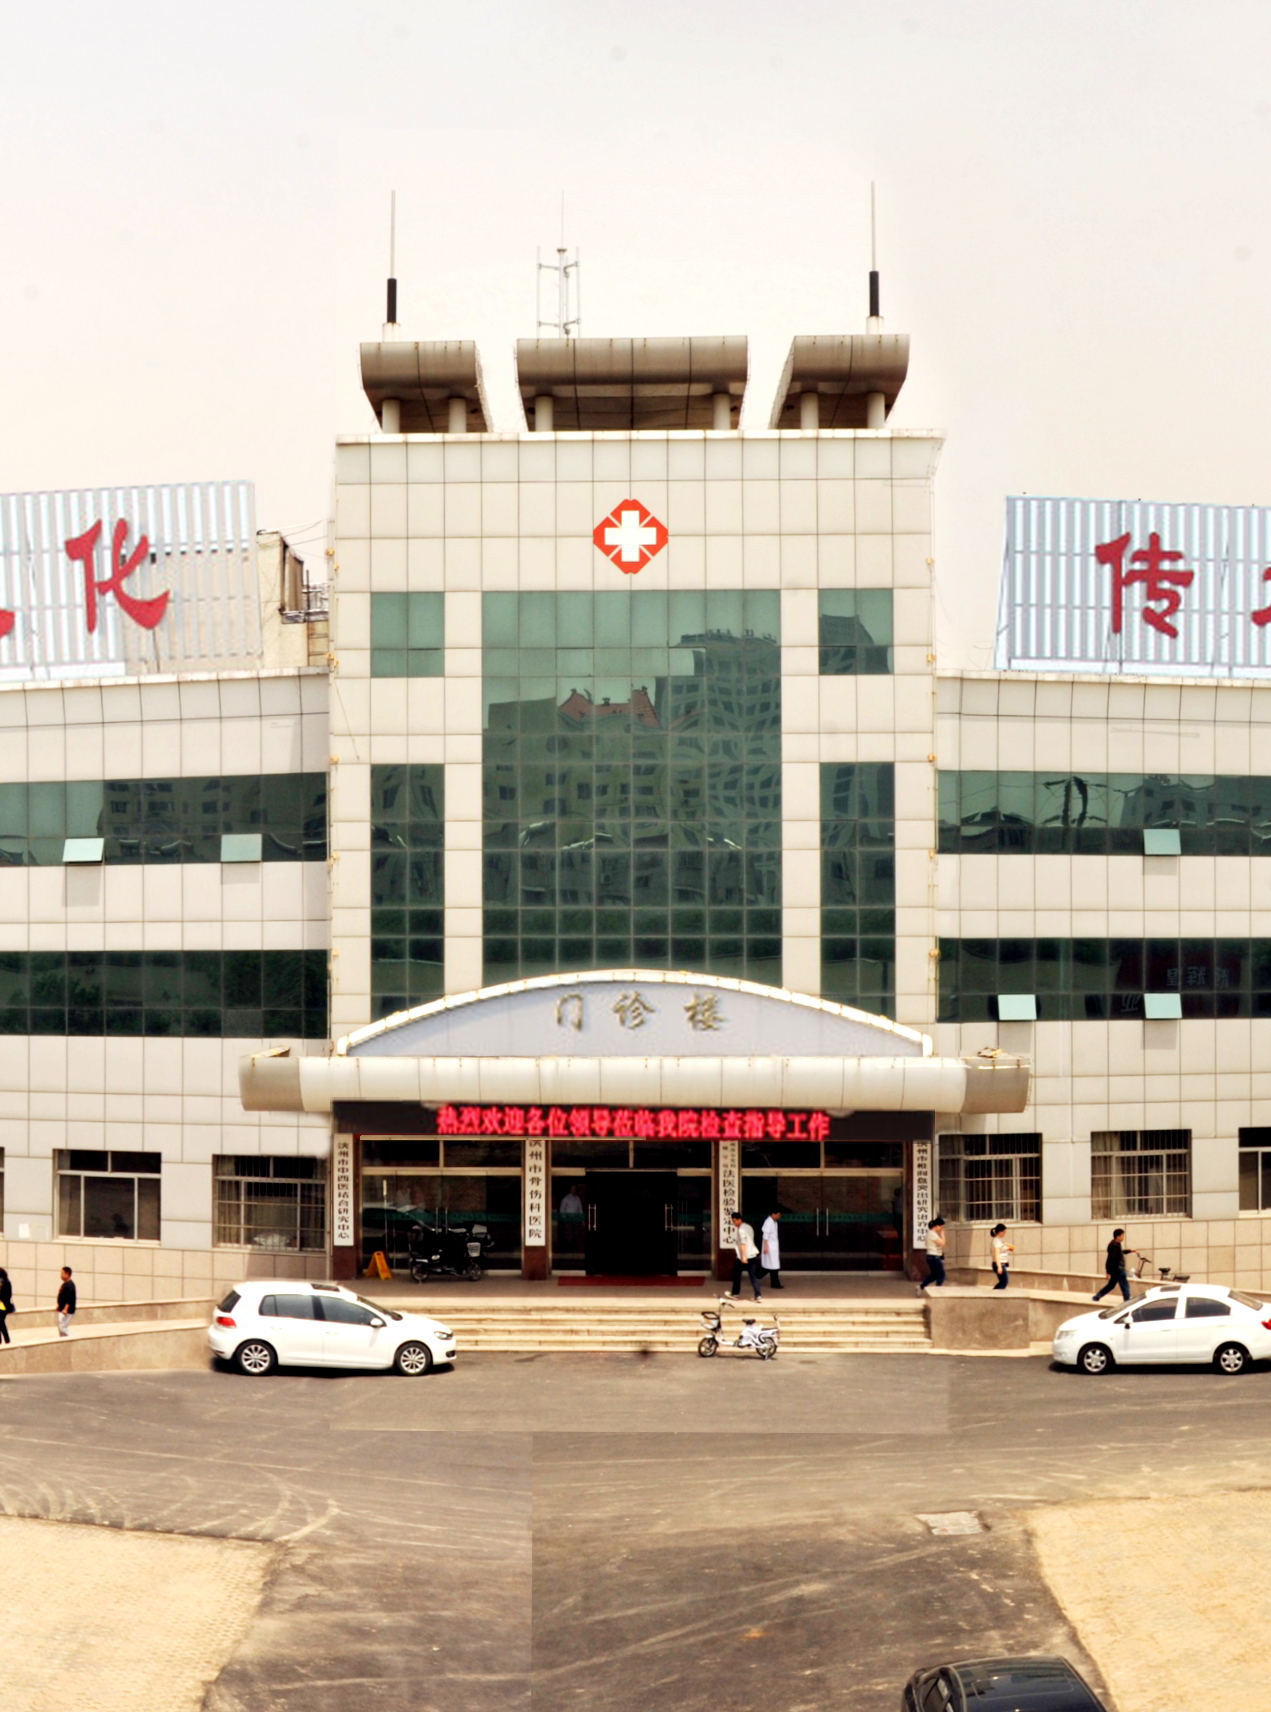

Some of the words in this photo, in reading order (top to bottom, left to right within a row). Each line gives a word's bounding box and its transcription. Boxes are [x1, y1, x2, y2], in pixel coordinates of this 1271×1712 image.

[553, 991, 730, 1032] 门诊楼
[437, 1104, 831, 1141] 热烈欢迎各位领导莅临我院检查指导工作
